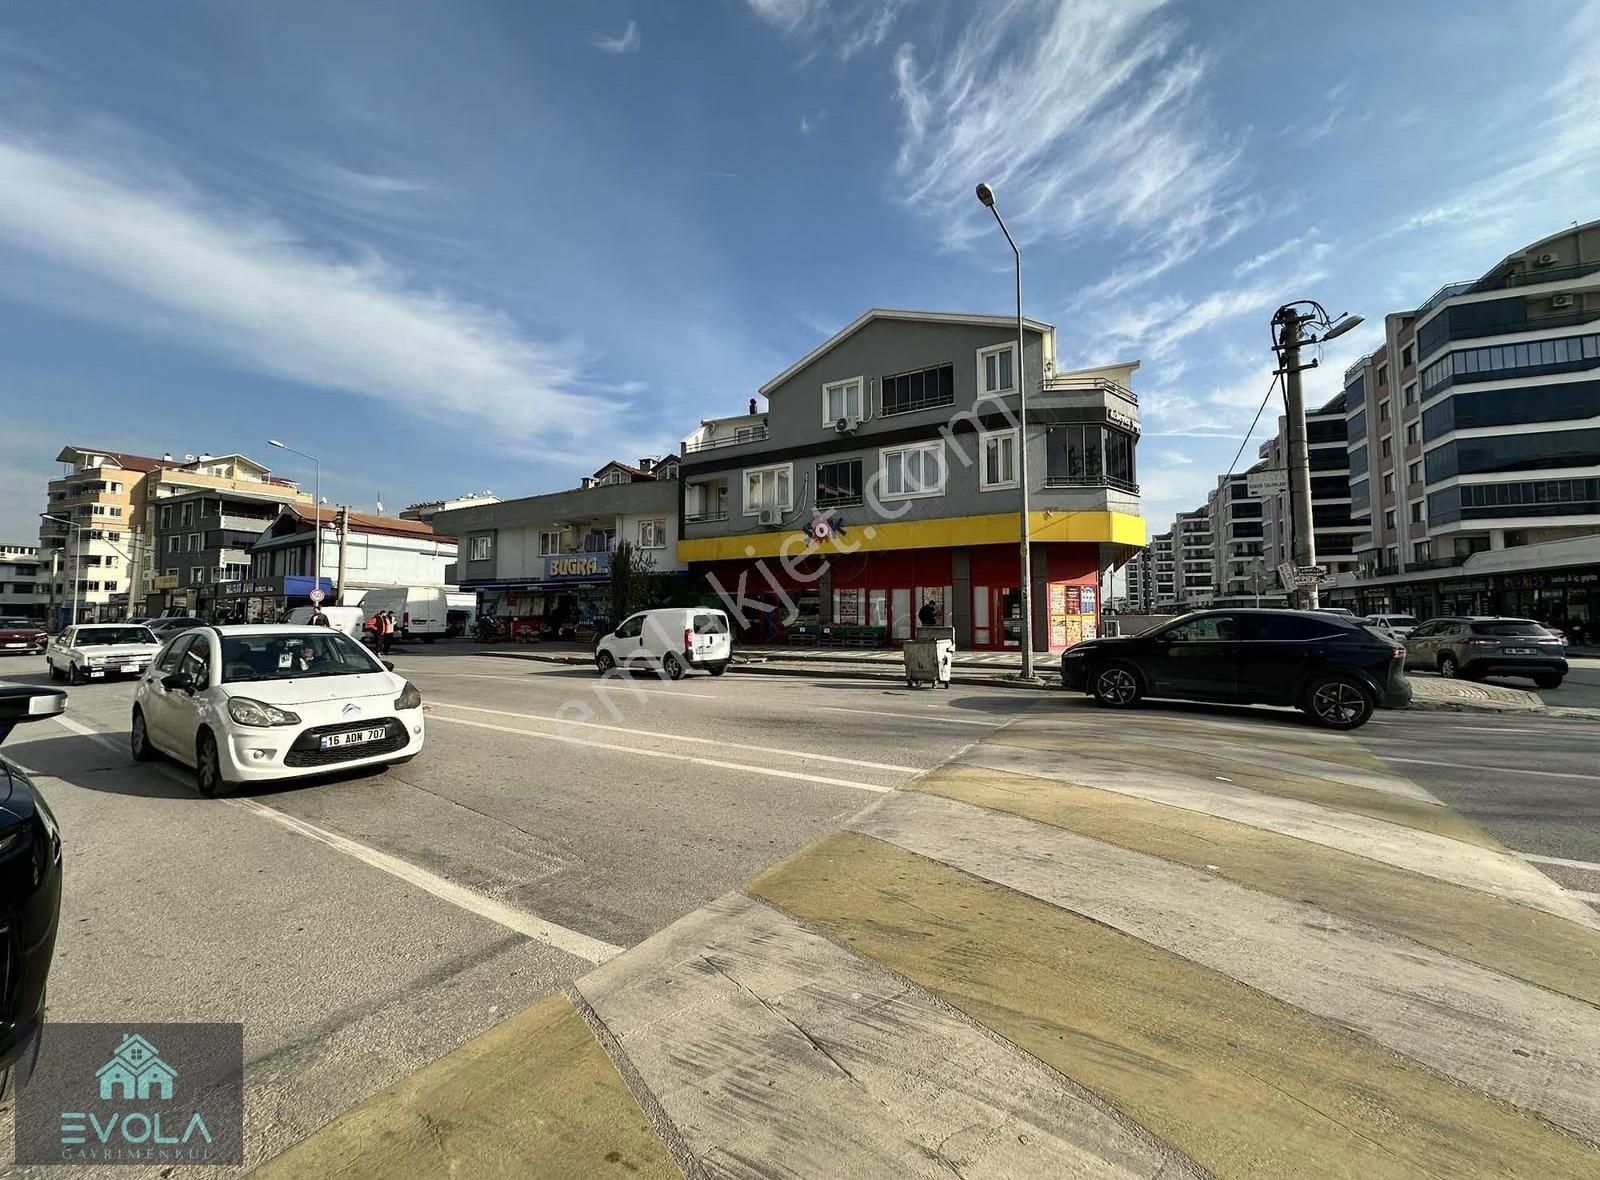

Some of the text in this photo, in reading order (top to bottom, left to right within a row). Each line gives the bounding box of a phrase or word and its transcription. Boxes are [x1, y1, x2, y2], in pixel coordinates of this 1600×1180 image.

[550, 556, 597, 576] BUĞRA
[328, 735, 340, 746] 16
[368, 729, 384, 740] 707
